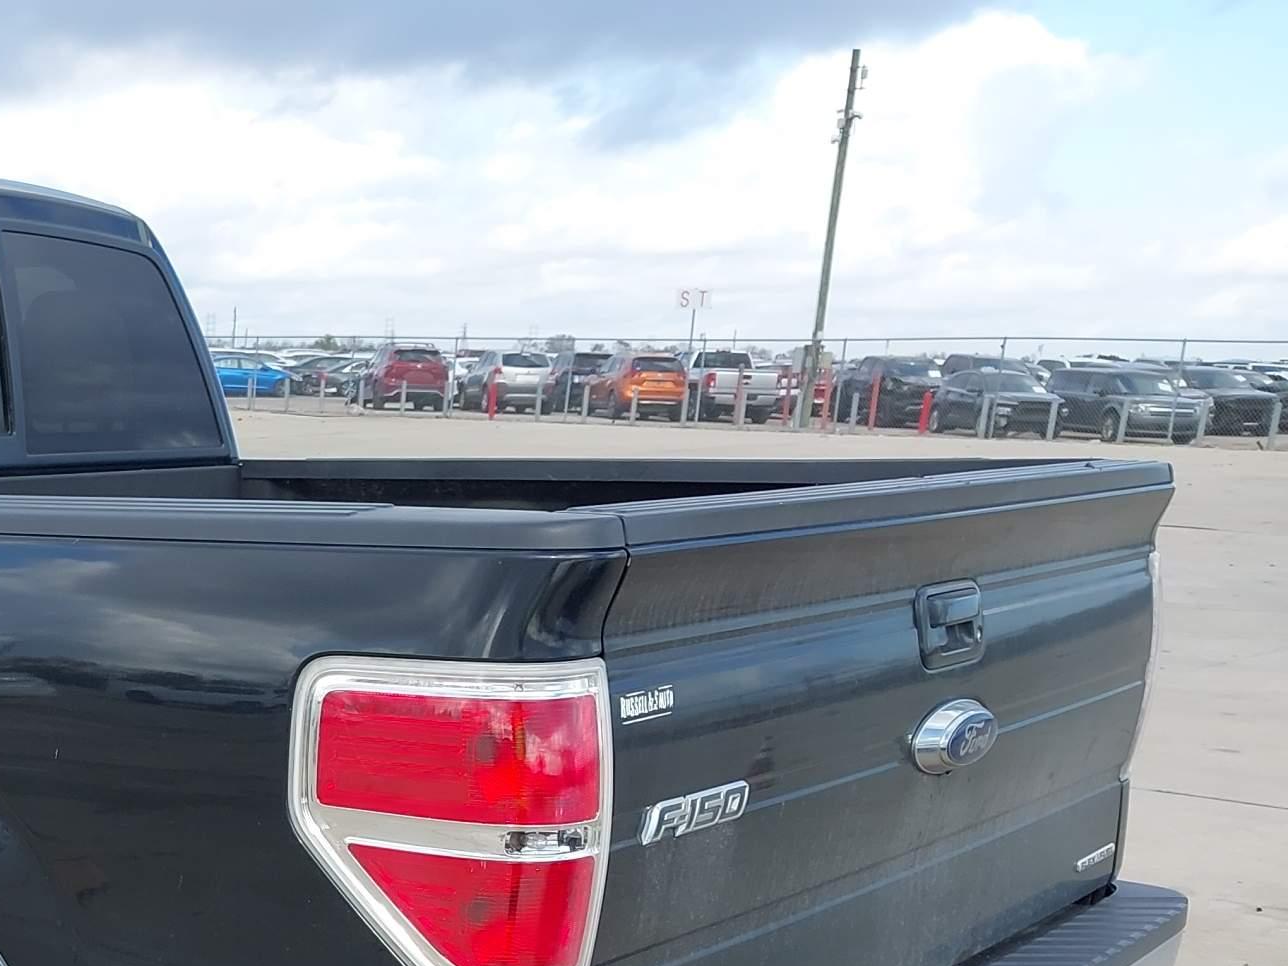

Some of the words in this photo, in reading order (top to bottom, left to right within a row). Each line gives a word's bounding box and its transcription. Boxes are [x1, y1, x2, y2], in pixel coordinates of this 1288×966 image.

[680, 290, 690, 308] S
[699, 290, 708, 307] T
[620, 696, 648, 719] RUSSELL
[960, 721, 991, 757] Ford
